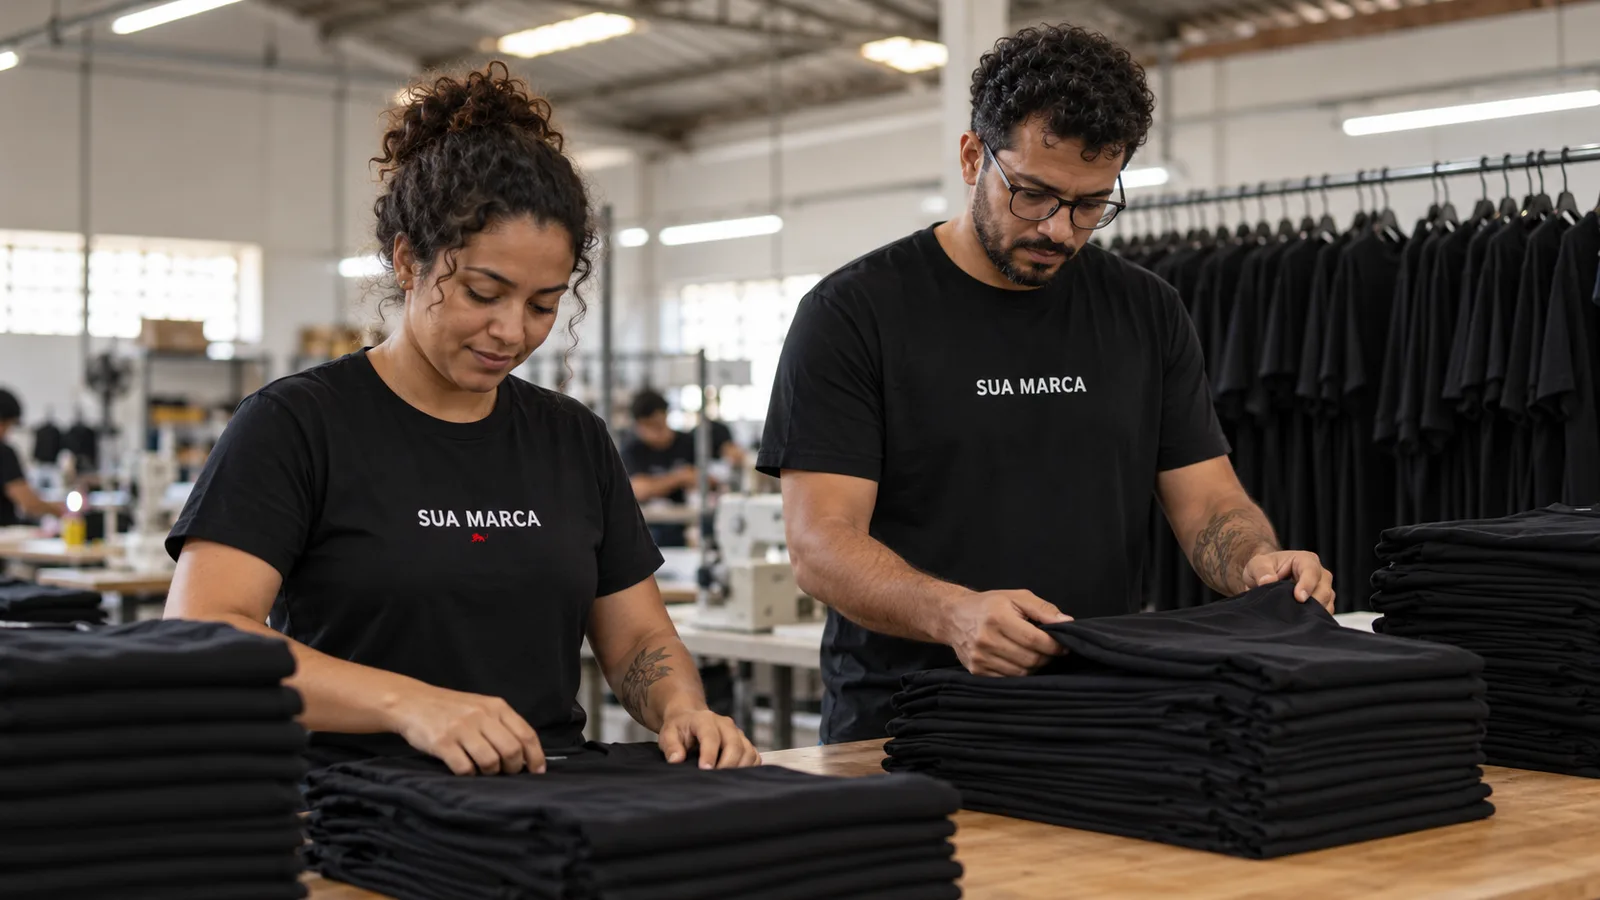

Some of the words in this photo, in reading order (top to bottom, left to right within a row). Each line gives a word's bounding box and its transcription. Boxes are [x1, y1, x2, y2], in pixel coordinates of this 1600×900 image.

[976, 379, 1014, 396] SUA
[1020, 376, 1087, 394] MARCA
[417, 509, 460, 527] SUA
[465, 510, 541, 527] MARCA
